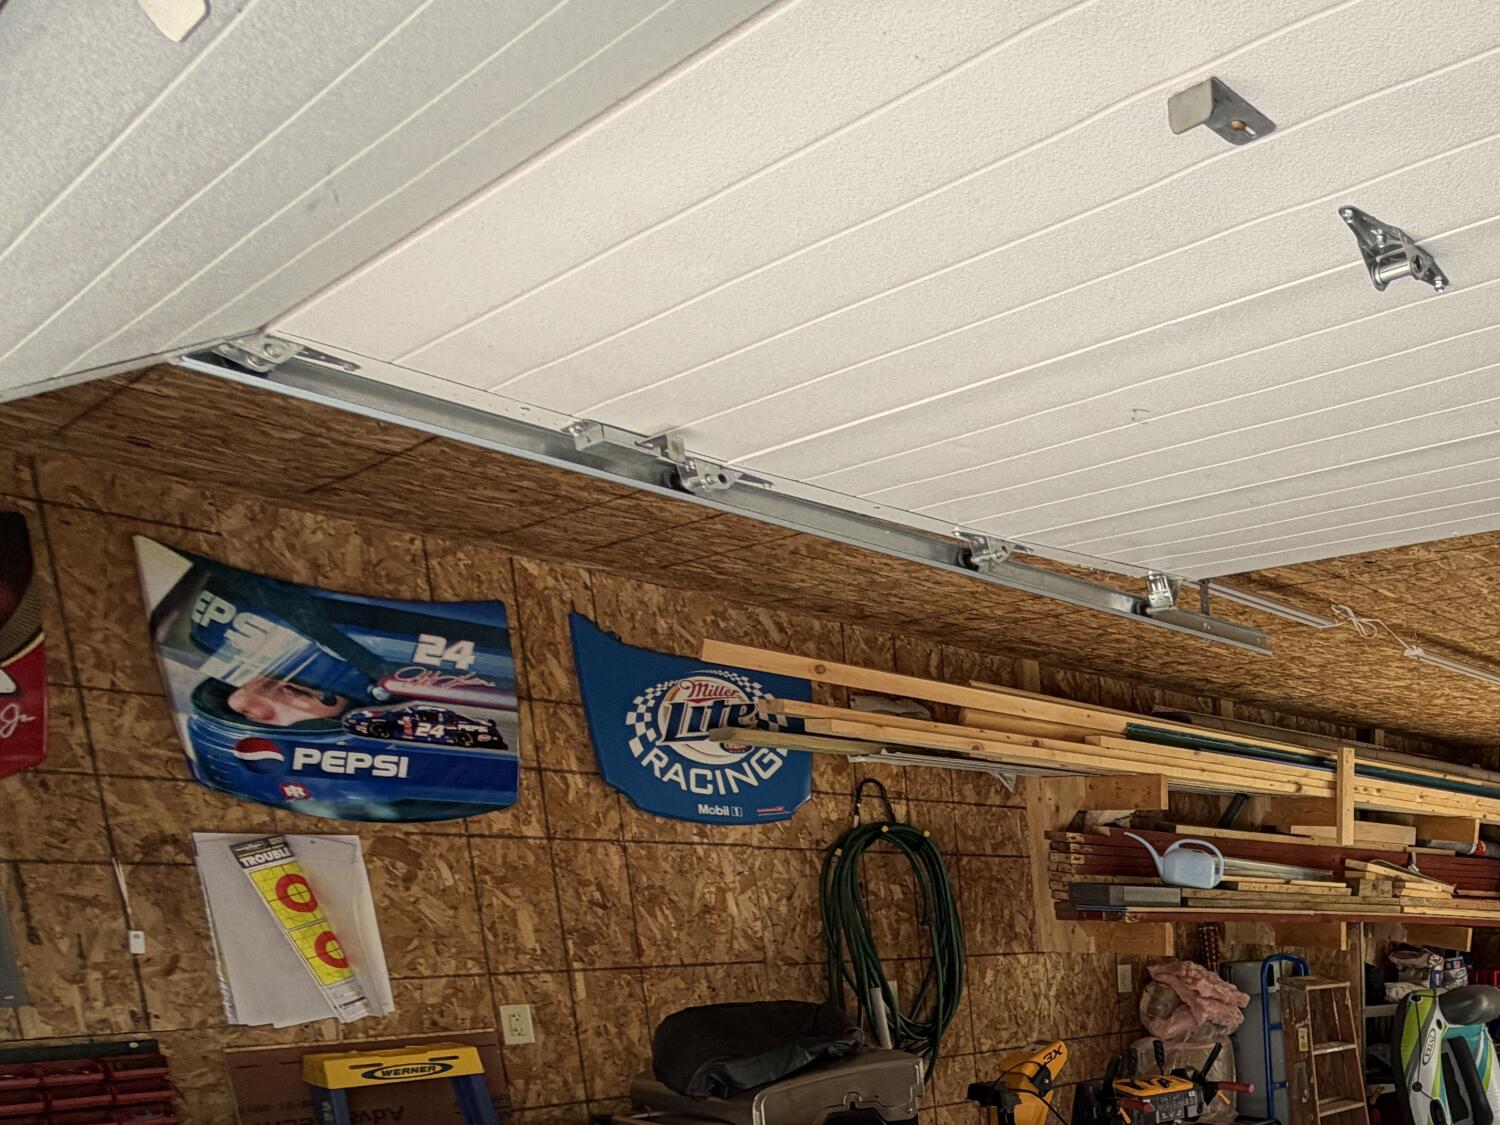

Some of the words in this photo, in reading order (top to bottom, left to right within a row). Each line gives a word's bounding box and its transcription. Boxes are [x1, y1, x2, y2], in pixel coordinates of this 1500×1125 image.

[413, 633, 475, 669] 24
[680, 680, 740, 698] Miller
[415, 722, 445, 739] 24
[656, 700, 757, 744] Lite
[292, 747, 409, 779] PEPSI
[641, 748, 783, 796] RACING
[698, 804, 730, 817] Mobil
[1043, 1045, 1064, 1066] 3X
[380, 1065, 438, 1078] WERNER
